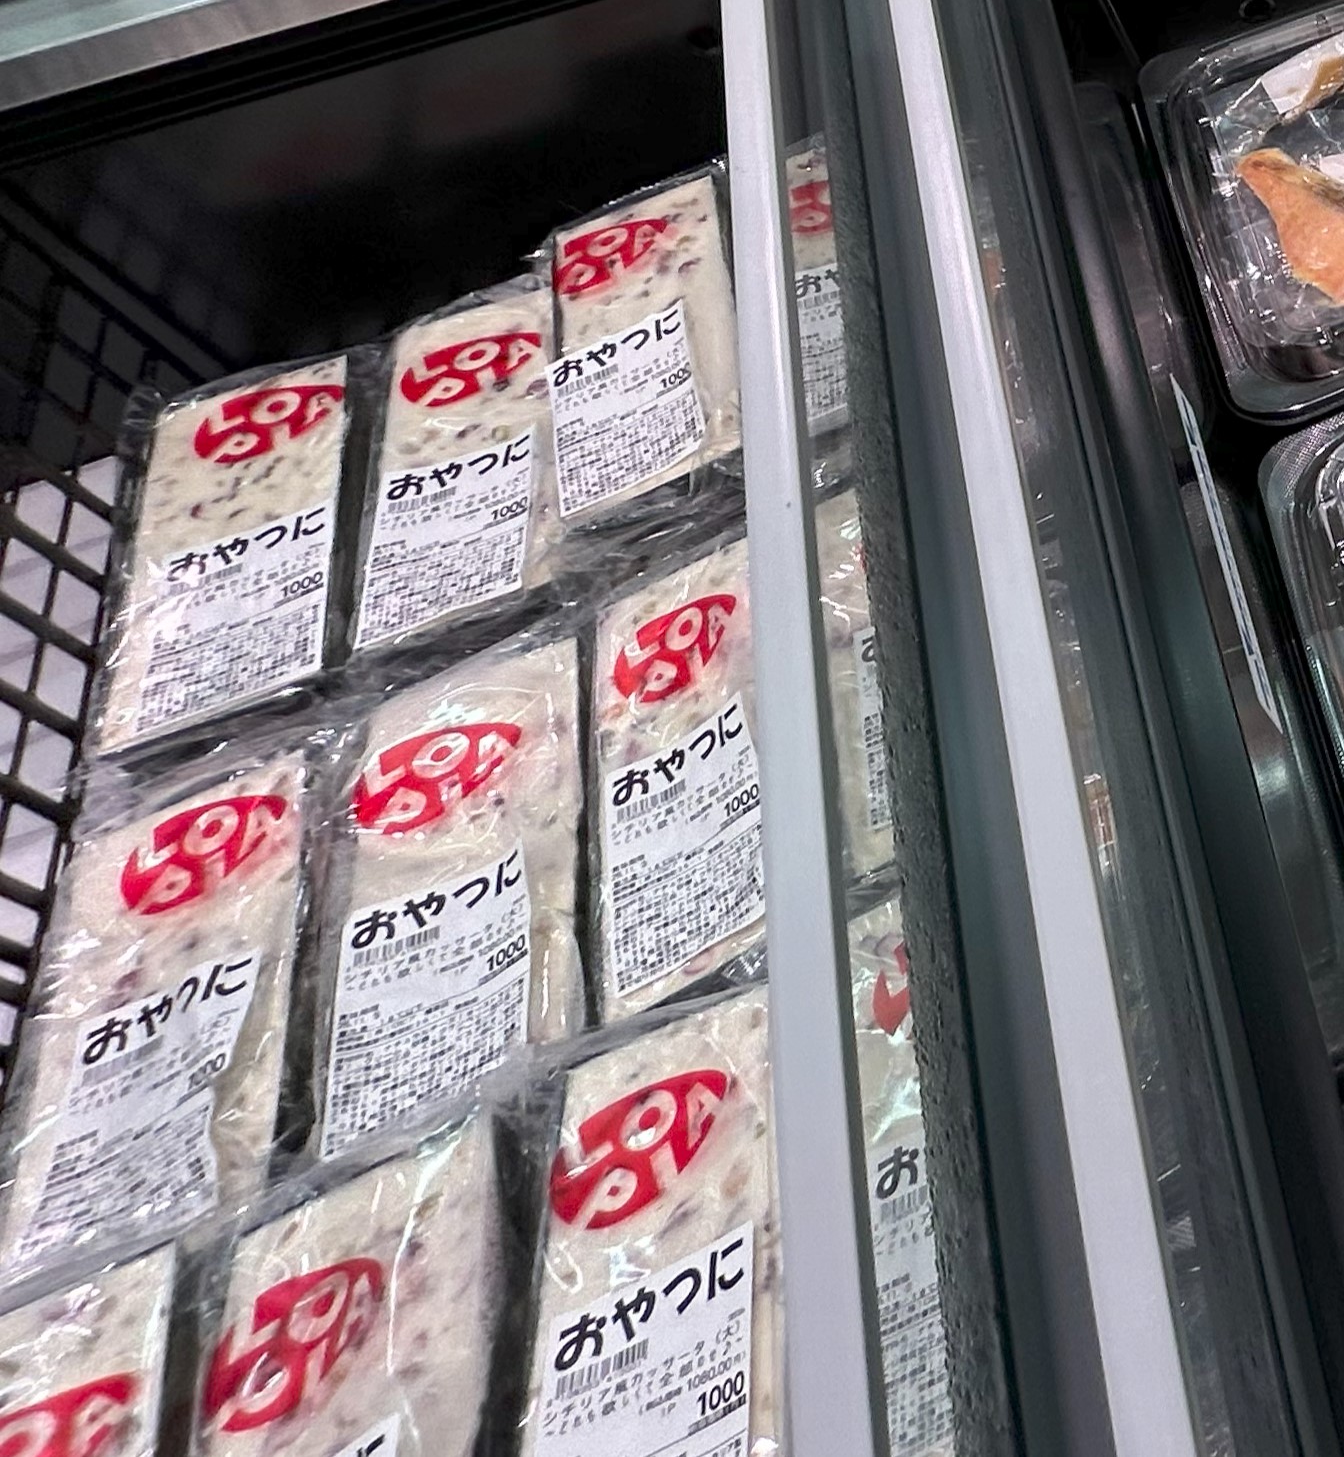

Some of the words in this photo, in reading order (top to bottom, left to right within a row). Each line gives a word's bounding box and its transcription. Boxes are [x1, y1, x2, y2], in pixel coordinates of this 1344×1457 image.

[552, 307, 682, 390] おやつに
[385, 434, 532, 502] おやつに
[280, 571, 324, 600] 1000
[610, 700, 744, 813] おやつに
[722, 780, 760, 818] 1000
[350, 848, 523, 961] おやつに
[485, 932, 526, 973] 1000
[83, 955, 254, 1067] おやつに
[553, 1236, 745, 1374] おやつに
[695, 1368, 746, 1418] 1000
